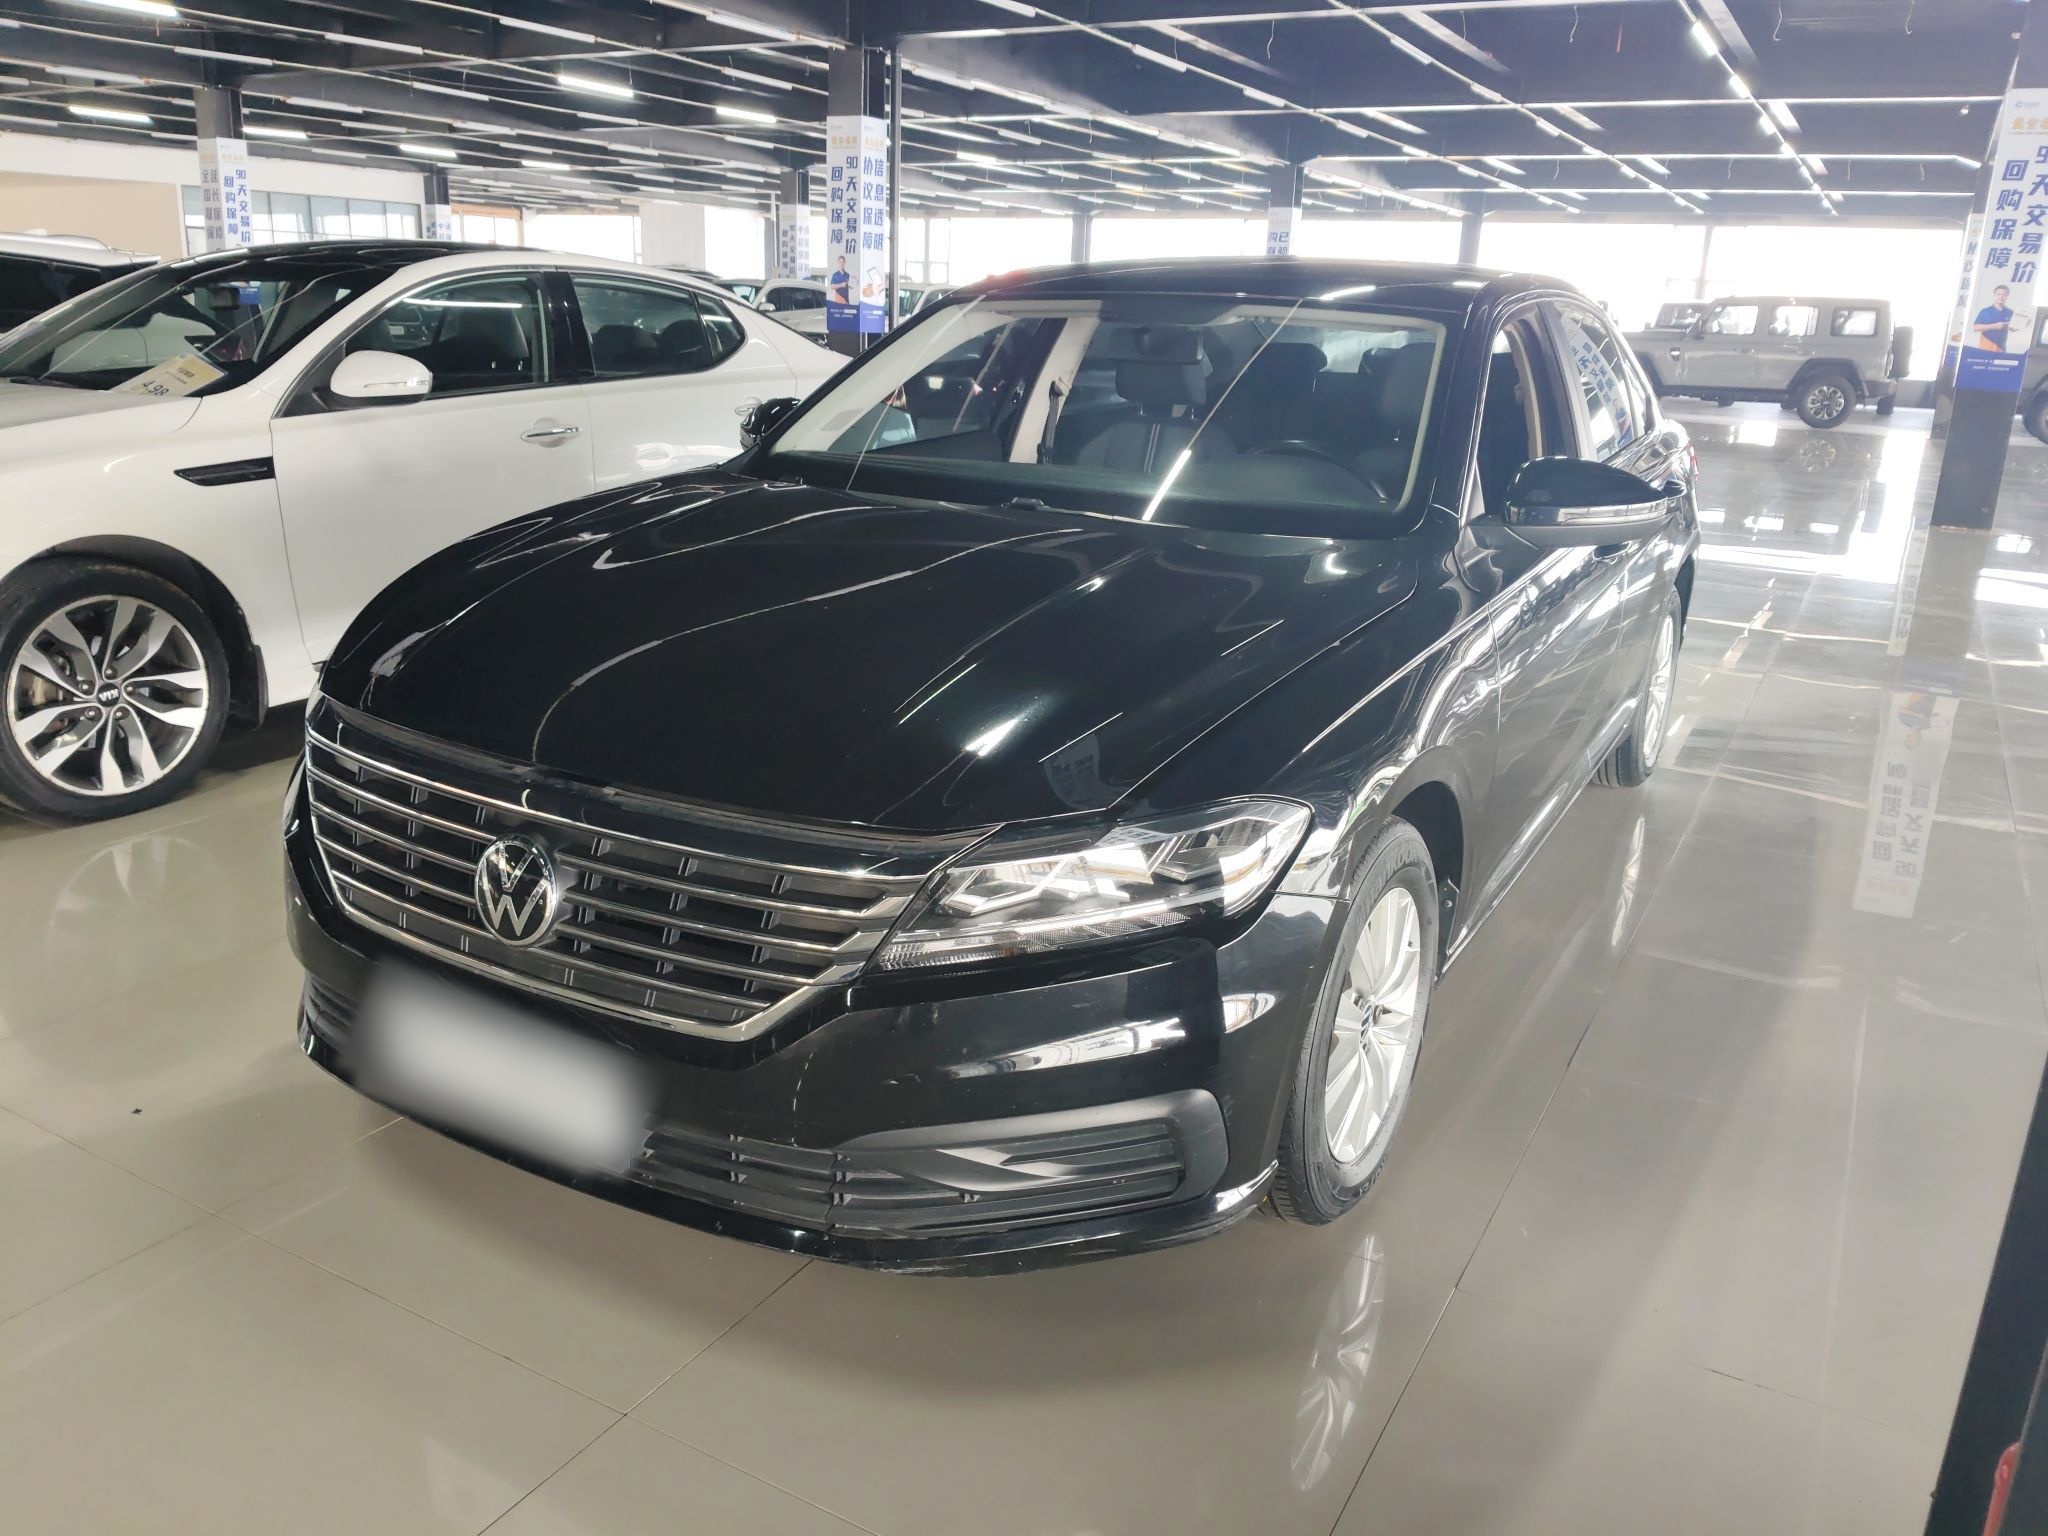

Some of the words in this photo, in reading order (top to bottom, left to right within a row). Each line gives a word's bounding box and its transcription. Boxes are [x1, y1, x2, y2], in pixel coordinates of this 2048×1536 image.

[224, 176, 238, 235] 回购保障
[235, 169, 251, 243] 90天交易价
[831, 166, 843, 245] 回购保障
[846, 156, 858, 254] 90天交易价
[863, 156, 873, 250] 协议保障
[873, 158, 884, 251] 信息透明
[1985, 159, 2029, 269] 回购保障
[2011, 145, 2048, 283] 9天交易价
[479, 838, 554, 940] VW
